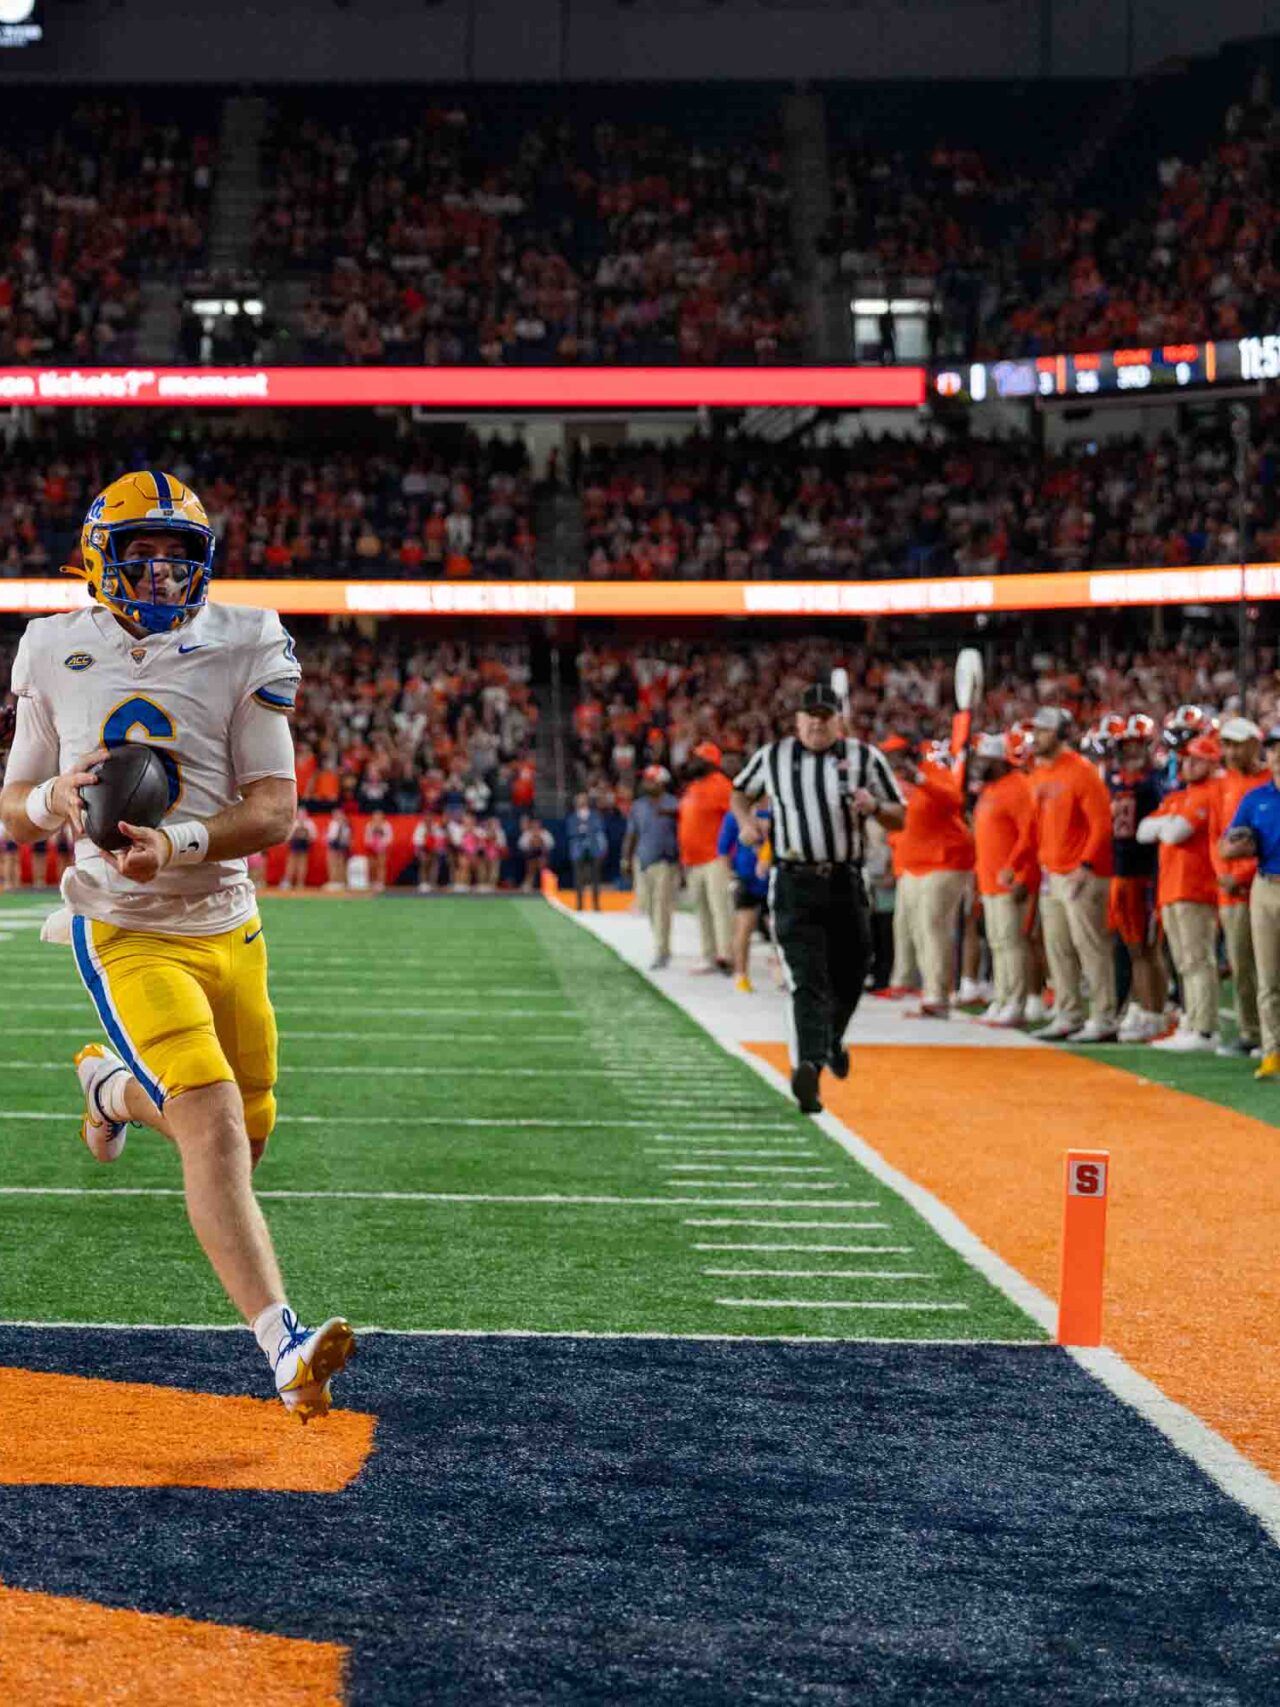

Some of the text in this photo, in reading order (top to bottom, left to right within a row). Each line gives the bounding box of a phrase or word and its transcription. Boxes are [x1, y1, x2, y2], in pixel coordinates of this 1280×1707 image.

[159, 373, 267, 396] moment
[68, 655, 90, 666] ACC
[1075, 1164, 1099, 1194] S
